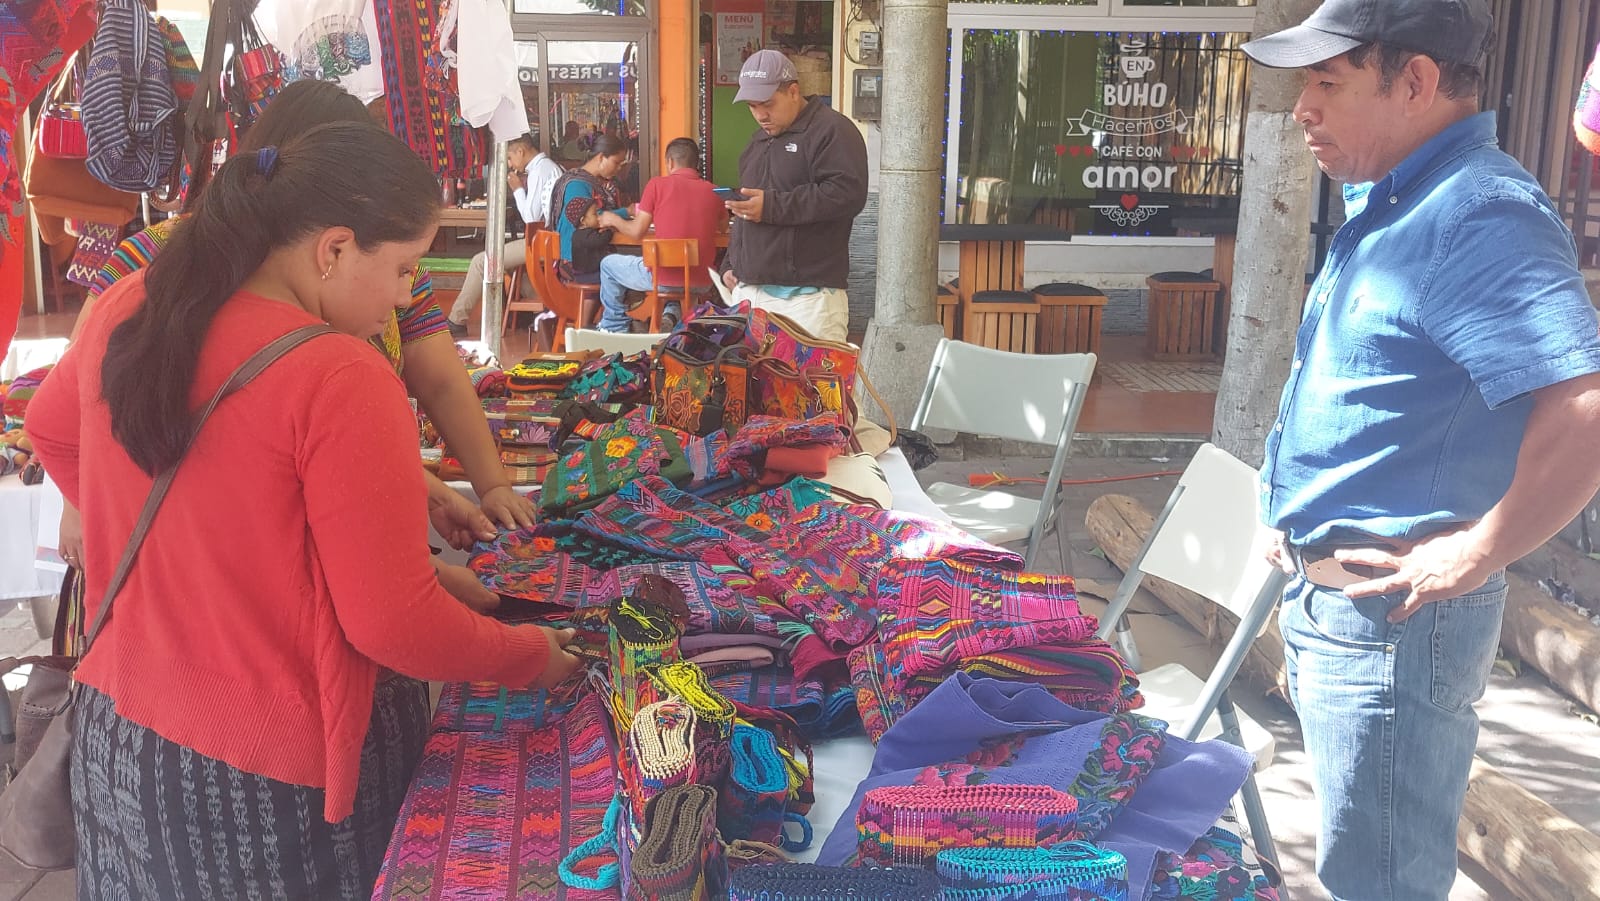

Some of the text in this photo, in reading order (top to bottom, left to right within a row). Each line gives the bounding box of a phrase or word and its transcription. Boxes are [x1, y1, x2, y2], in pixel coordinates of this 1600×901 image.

[1127, 60, 1145, 71] EN
[1103, 81, 1168, 108] BÚHO
[1091, 115, 1174, 133] Hacemos
[1102, 144, 1162, 158] CAFÉ CON
[1082, 165, 1178, 189] amor
